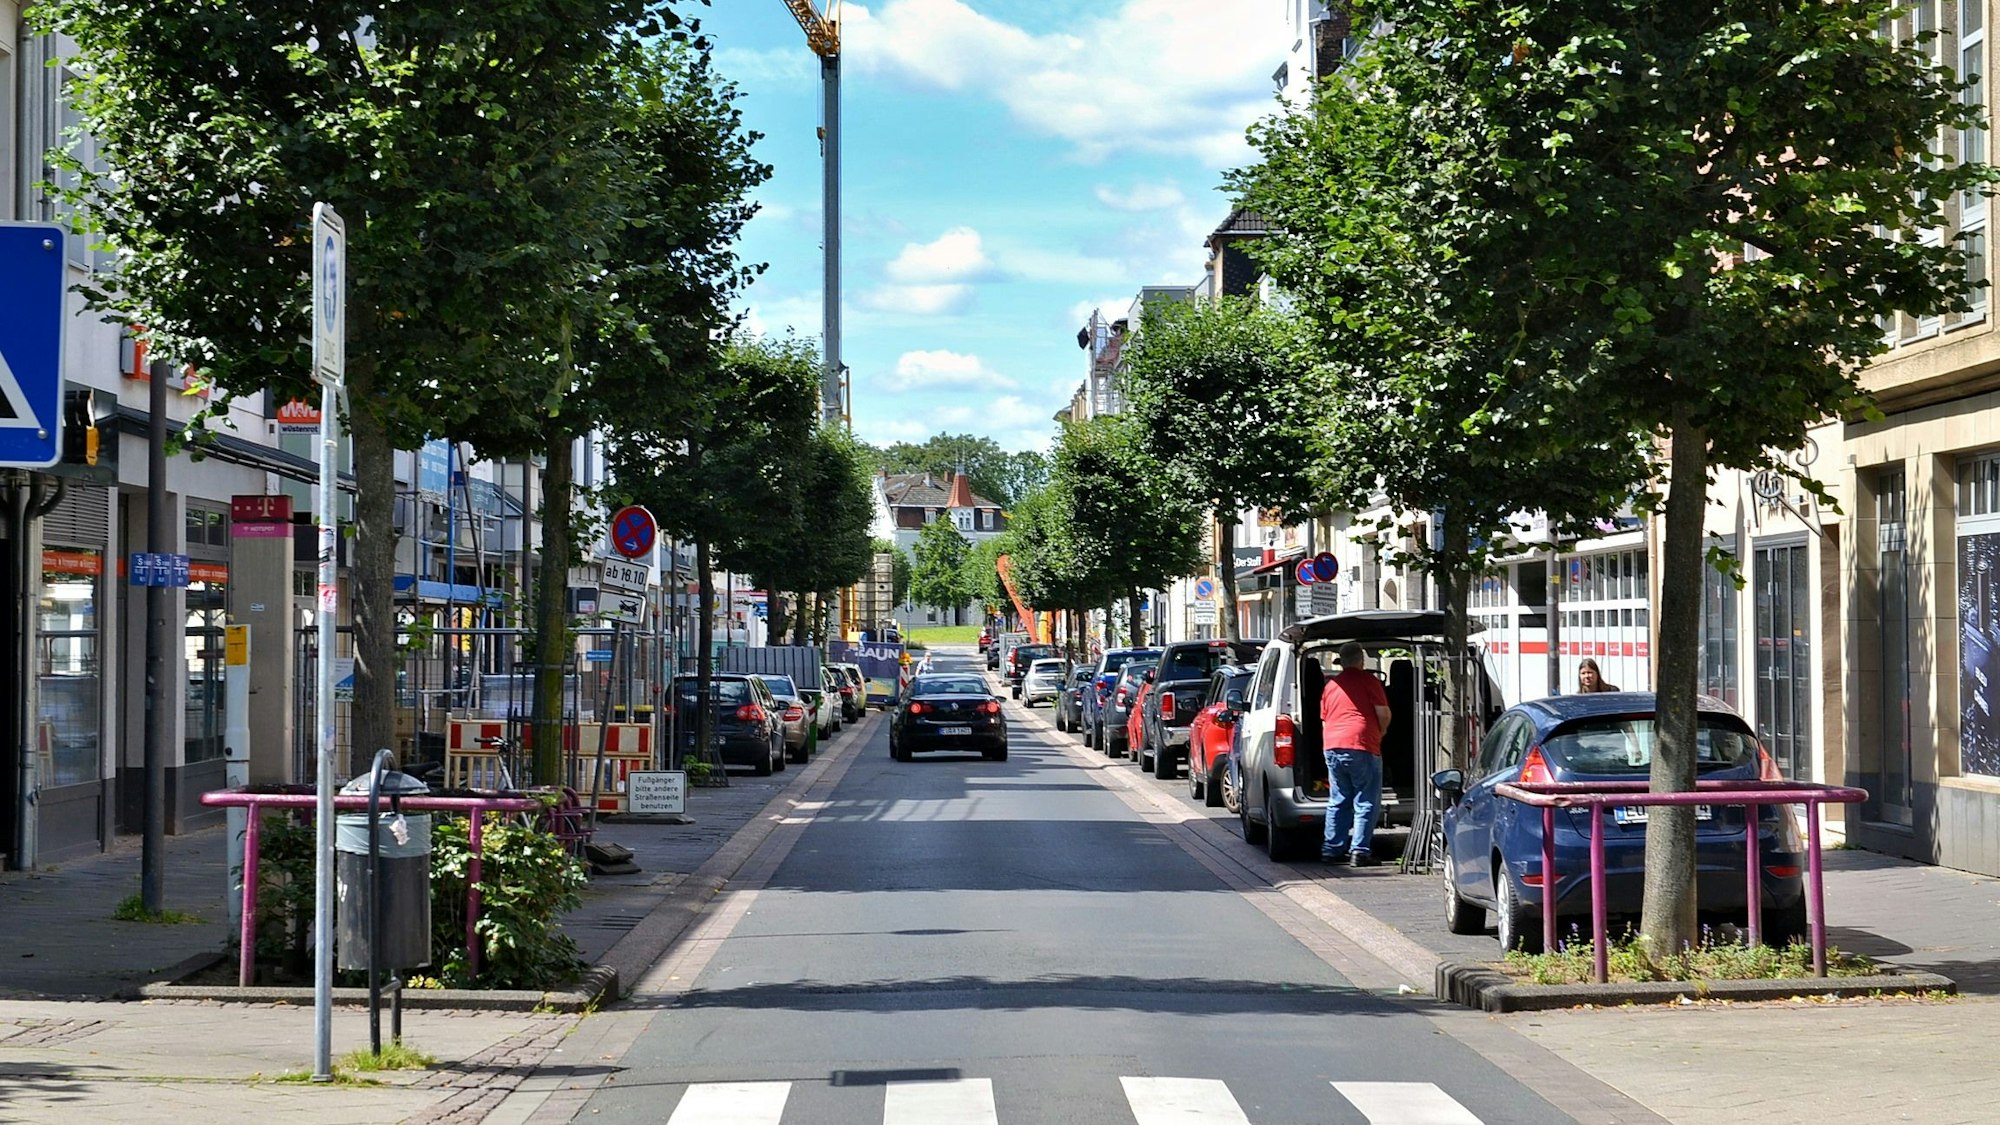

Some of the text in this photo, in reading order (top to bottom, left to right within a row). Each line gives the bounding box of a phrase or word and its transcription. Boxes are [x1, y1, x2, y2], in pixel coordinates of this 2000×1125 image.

[281, 425, 318, 433] wüstenrot
[605, 564, 619, 579] ab
[638, 776, 675, 784] Fußgänger
